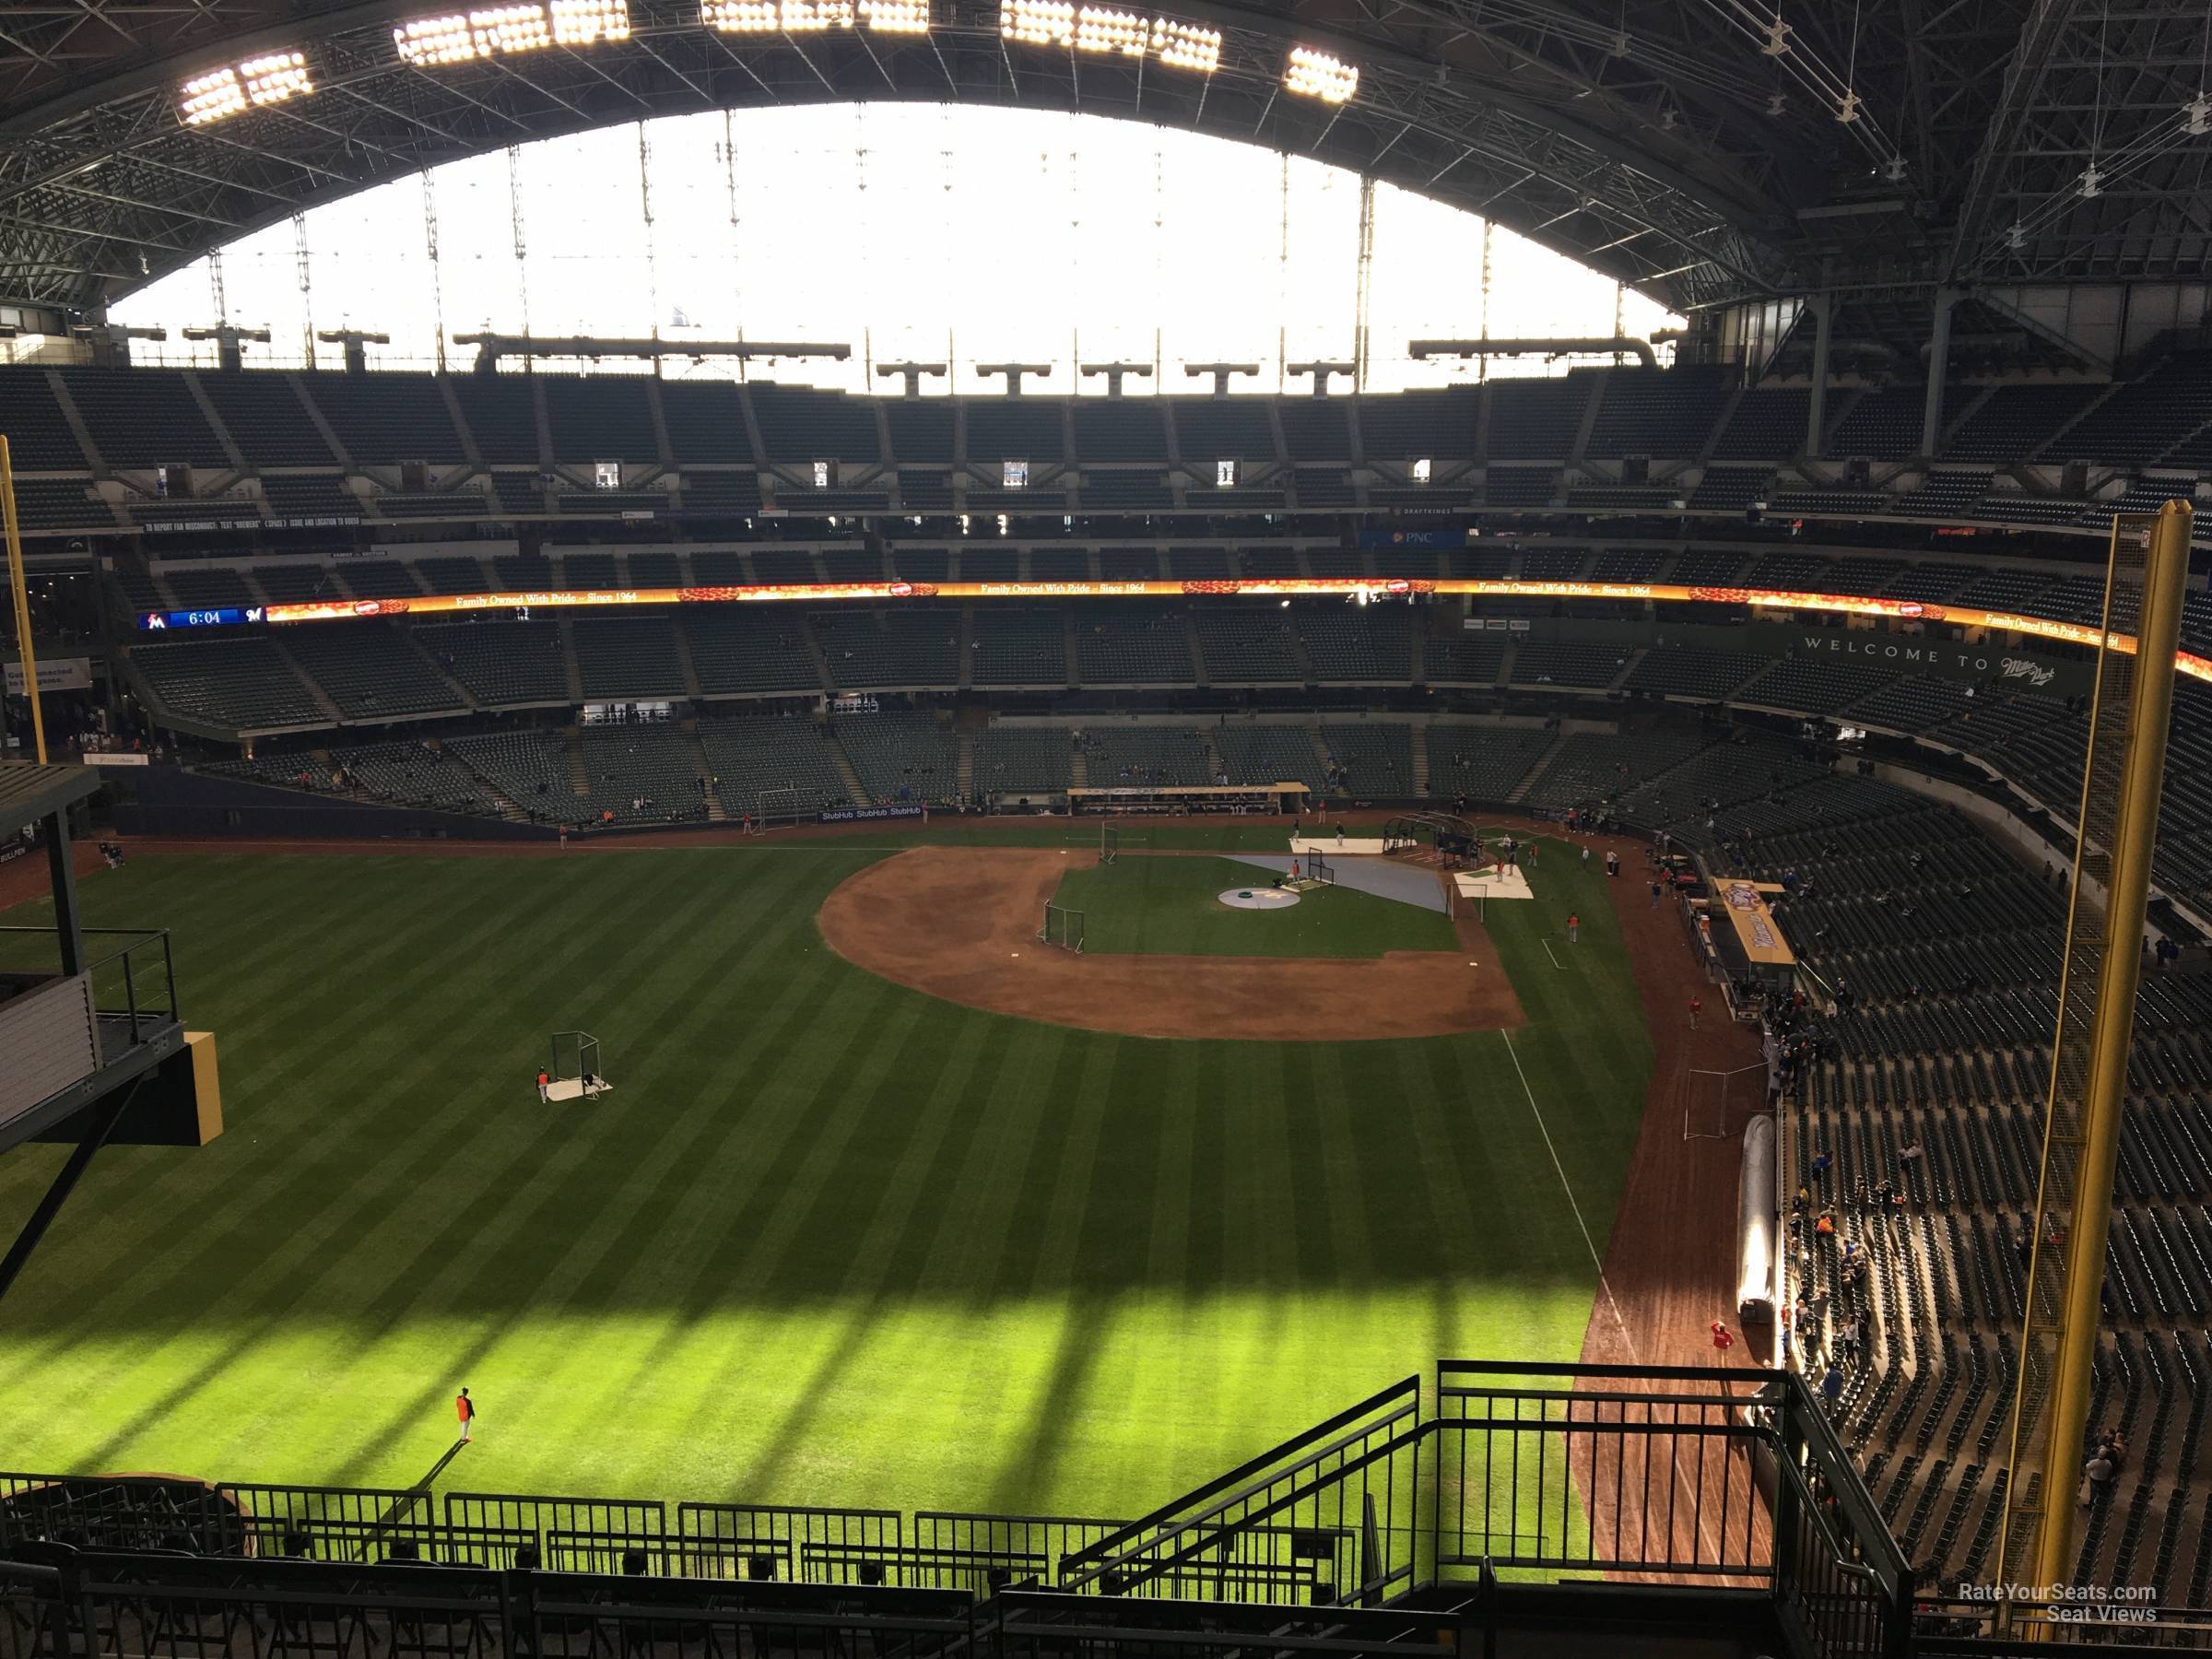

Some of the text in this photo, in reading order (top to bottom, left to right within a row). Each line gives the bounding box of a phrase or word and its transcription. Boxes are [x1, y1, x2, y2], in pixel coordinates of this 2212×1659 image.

[1406, 532, 1432, 543] PNC
[982, 584, 1010, 594] Family
[1012, 584, 1042, 593] Owned
[1045, 583, 1066, 593] With
[1068, 583, 1090, 593] Pride
[1100, 583, 1123, 593] Since
[1125, 583, 1145, 592] 1964
[1478, 582, 1508, 594] Family
[1511, 582, 1543, 593] Owned
[1546, 583, 1566, 593] With
[1568, 583, 1592, 594] Pride
[1602, 585, 1627, 594] Since
[1630, 587, 1651, 595] 1964
[456, 596, 487, 607] Family
[489, 595, 524, 605] Owned
[525, 594, 548, 604] With
[551, 593, 576, 603] Pride
[587, 593, 613, 602] Since
[616, 592, 637, 601] 1964
[189, 611, 220, 624] 6:04
[1985, 614, 2016, 629] Family
[2061, 626, 2080, 639] Pride
[2087, 630, 2104, 643] Sinc
[2106, 634, 2119, 647] 964
[1805, 637, 1937, 663] WELCOME
[1958, 655, 1987, 670] TO
[822, 806, 921, 820] StubHub StubHub StubHub
